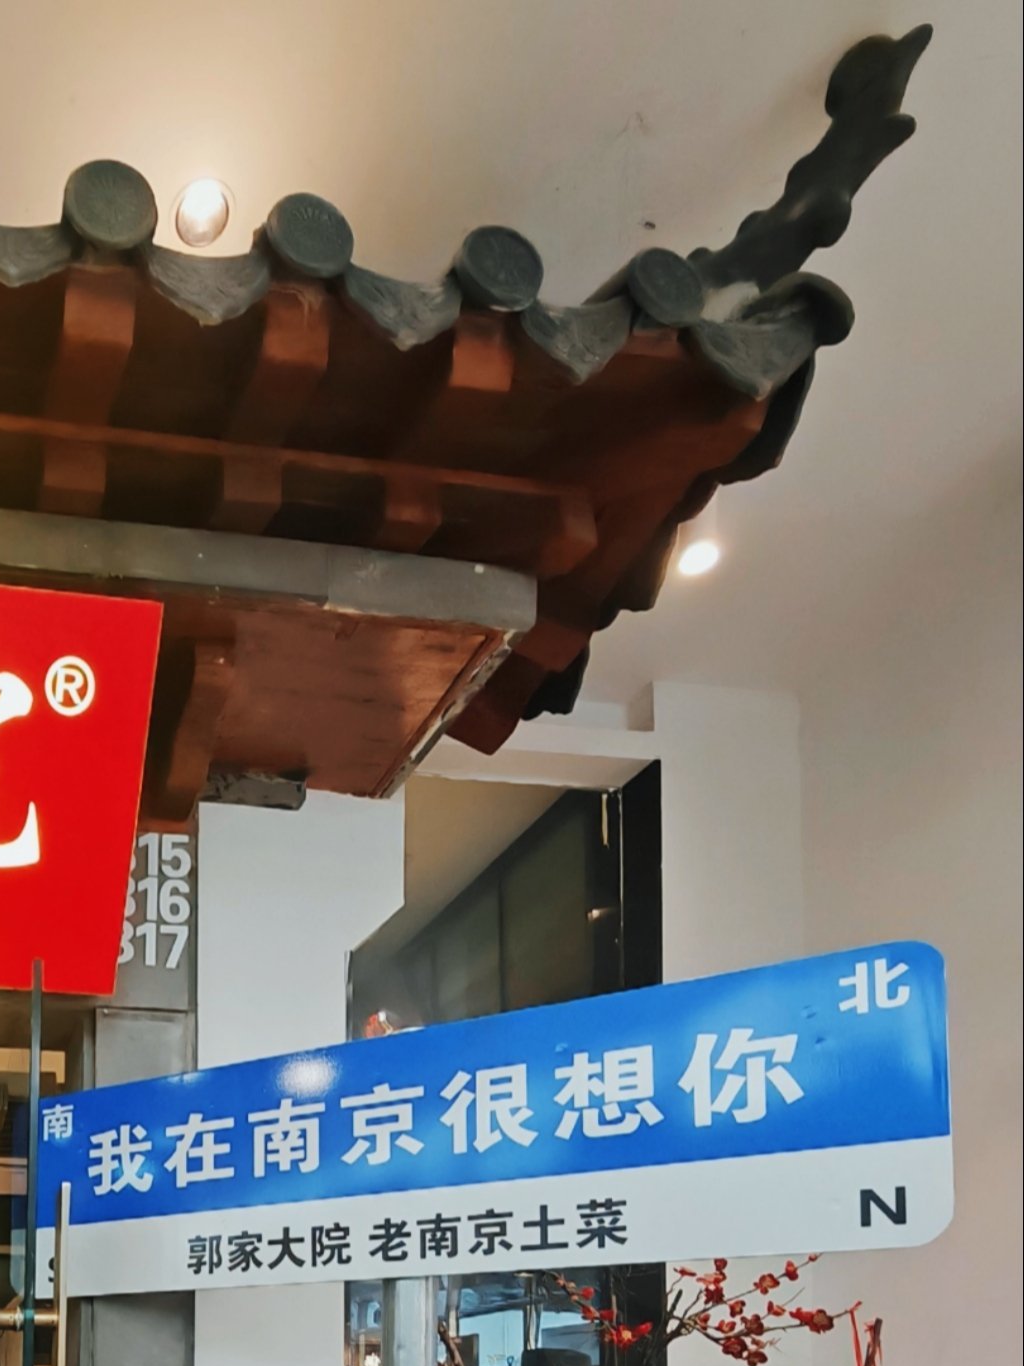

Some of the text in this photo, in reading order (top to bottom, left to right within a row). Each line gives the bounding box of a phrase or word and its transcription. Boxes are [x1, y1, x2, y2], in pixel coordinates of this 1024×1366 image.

[132, 832, 192, 879] 15
[837, 958, 911, 1015] 北
[42, 1103, 74, 1141] 南
[86, 1027, 805, 1196] 我在南京很想你
[859, 1186, 907, 1228] N
[187, 1198, 629, 1276] 郭家大院 老南京土菜
